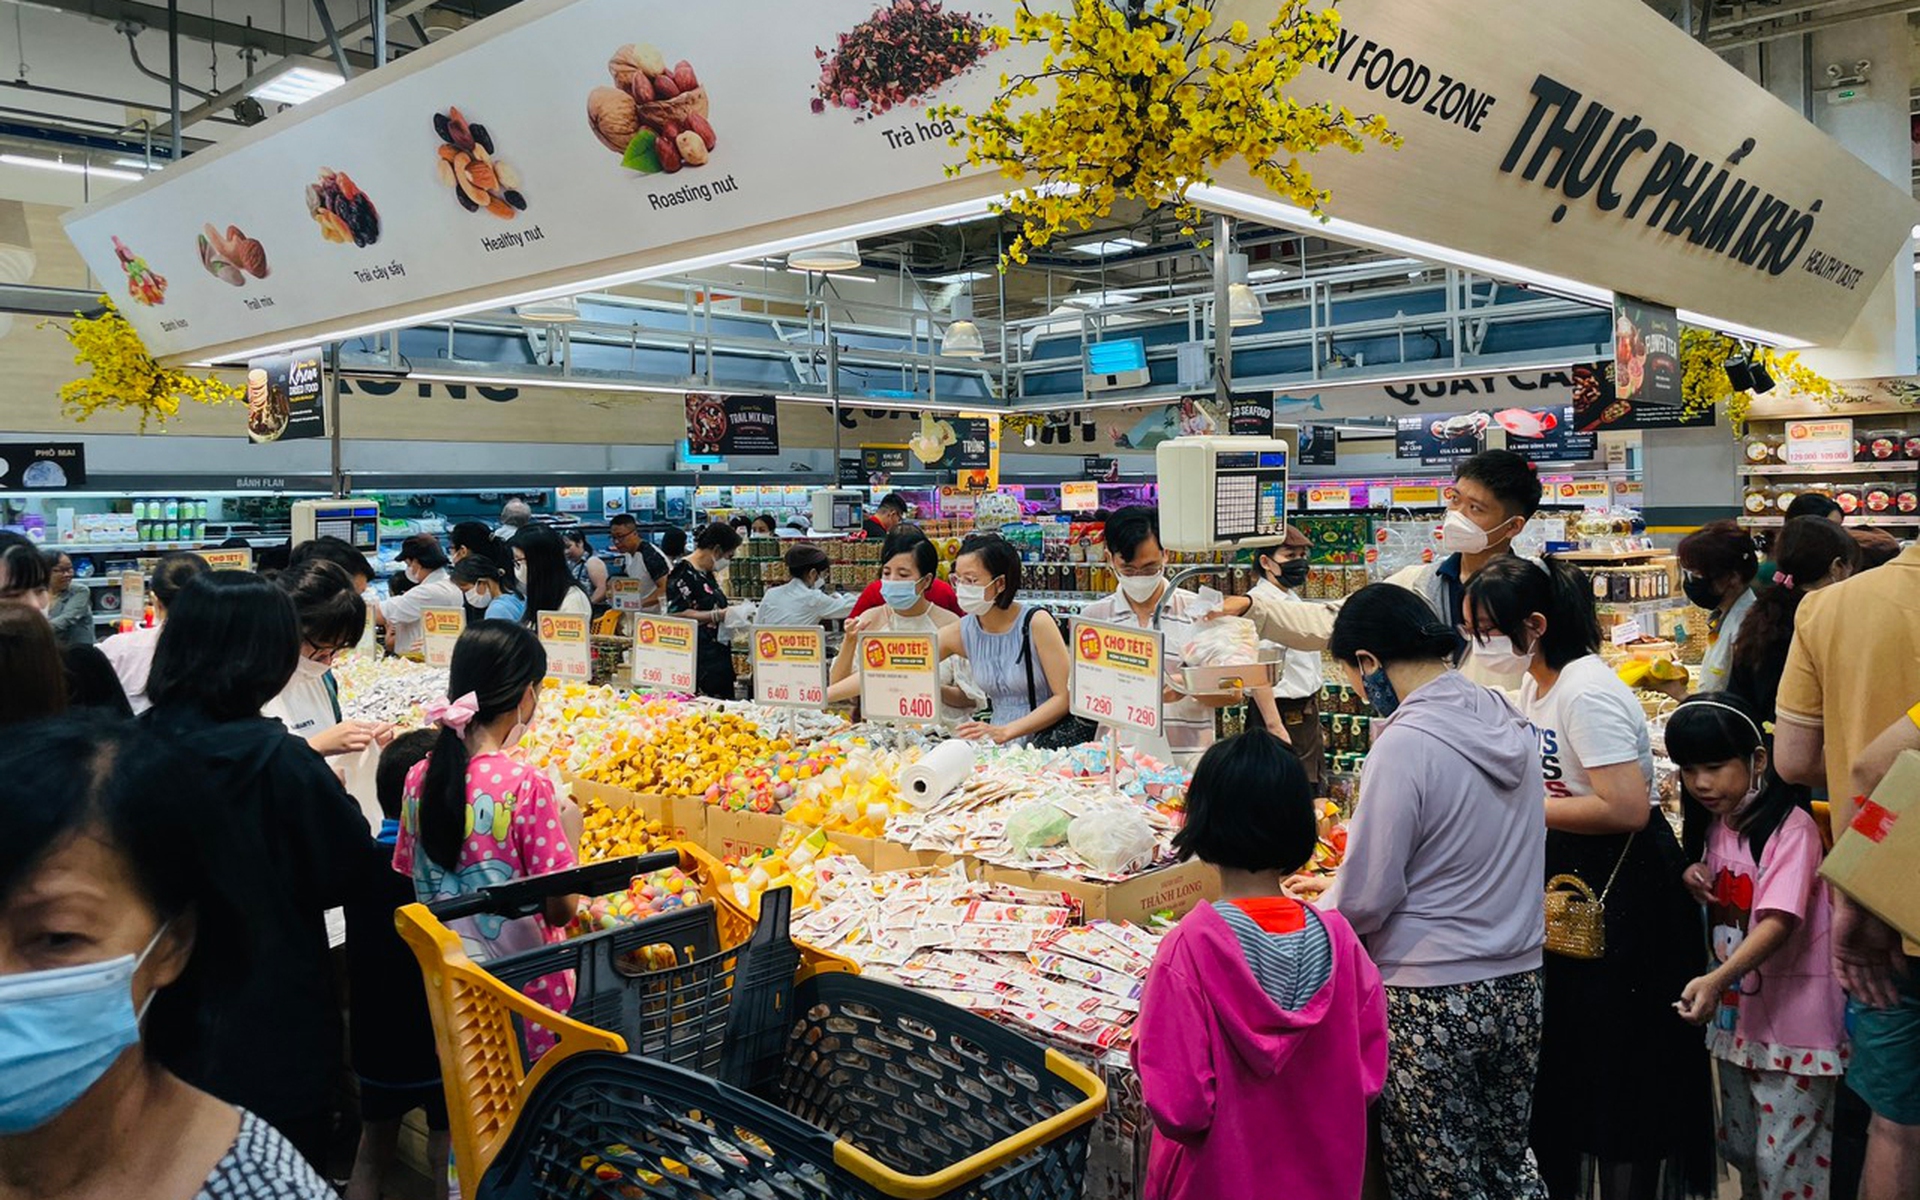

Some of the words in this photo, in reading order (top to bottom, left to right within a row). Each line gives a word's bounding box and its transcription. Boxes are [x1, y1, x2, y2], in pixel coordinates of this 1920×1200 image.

[1347, 39, 1431, 105] FOOD
[1423, 74, 1496, 133] ZONE
[882, 124, 915, 150] Trà
[1500, 73, 1658, 224] THỰC
[1624, 137, 1760, 254] PHẨM
[1728, 199, 1823, 276] KHÔ
[648, 182, 712, 210] Roasting
[712, 174, 738, 194] nut
[481, 232, 524, 252] Healthy
[524, 225, 545, 241] nut
[1801, 248, 1844, 281] HEALTHY
[1836, 264, 1864, 290] TASTE
[1240, 405, 1272, 419] SEAFOOD
[57, 449, 76, 457] MAI
[236, 476, 261, 487] BÁNH
[262, 478, 284, 487] FLAN
[900, 697, 933, 718] 6.400
[1085, 695, 1112, 716] 7.290
[1127, 705, 1155, 727] 7.290
[1176, 880, 1202, 897] LONG
